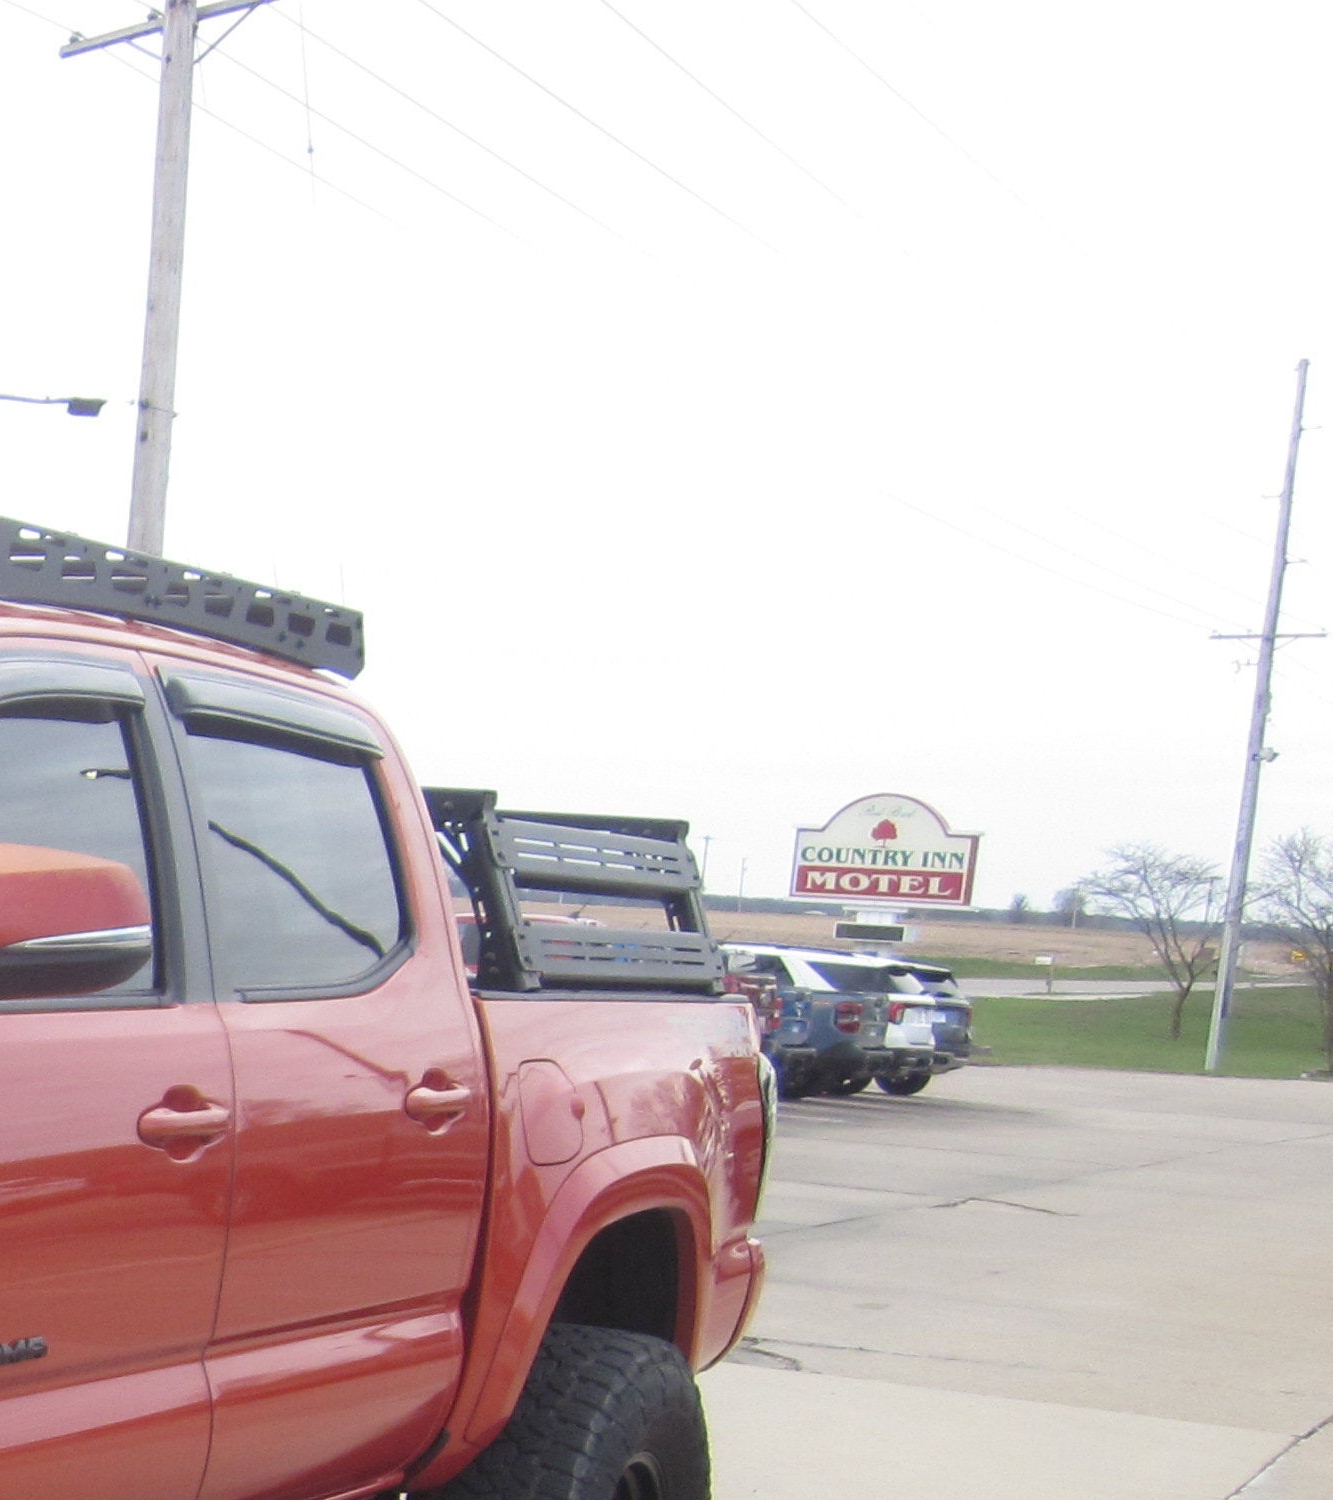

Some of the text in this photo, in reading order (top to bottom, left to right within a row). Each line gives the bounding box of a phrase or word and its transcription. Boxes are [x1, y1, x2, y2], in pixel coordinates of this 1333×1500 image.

[801, 846, 965, 870] COUNTRY INN
[805, 871, 954, 896] MOTEL
